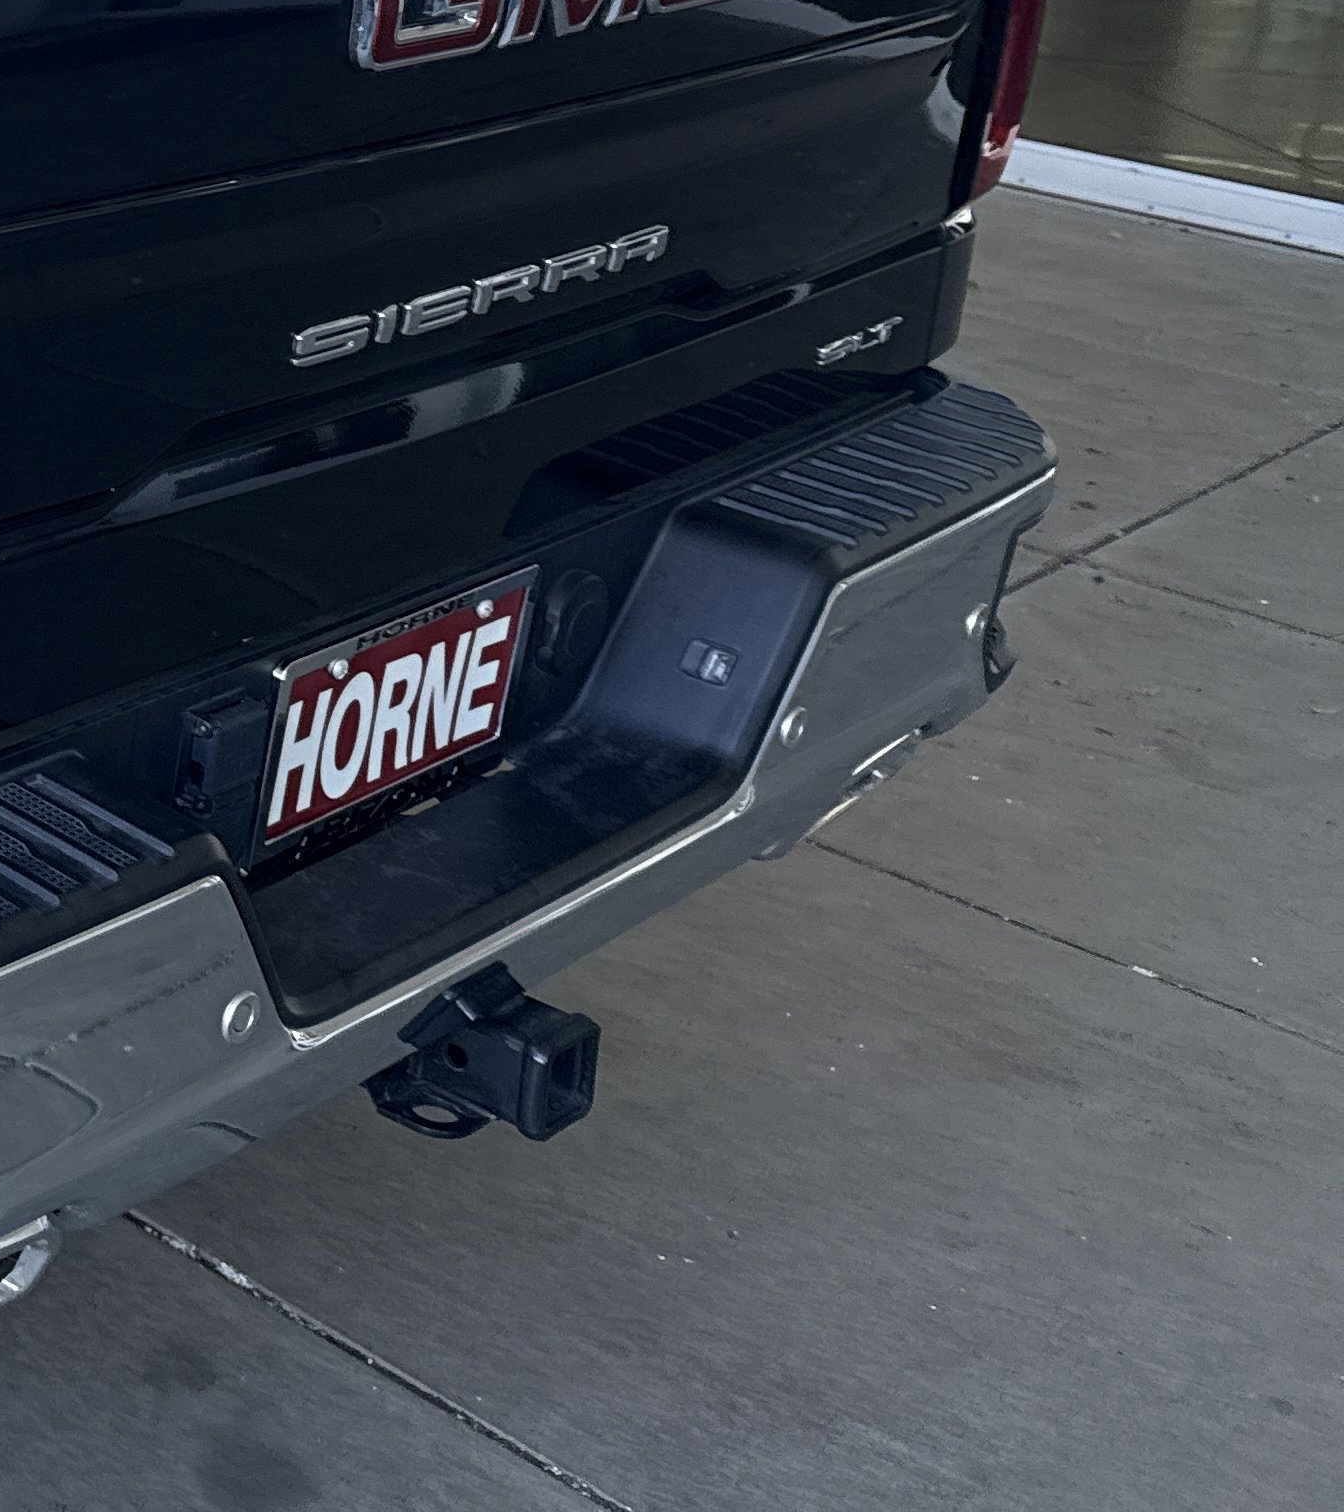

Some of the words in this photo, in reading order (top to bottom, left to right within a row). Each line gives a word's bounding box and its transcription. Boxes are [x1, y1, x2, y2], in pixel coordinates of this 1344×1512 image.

[290, 224, 670, 368] SIERRA
[815, 315, 904, 366] SLT
[355, 590, 478, 651] HORNE
[266, 614, 512, 827] HORNE
